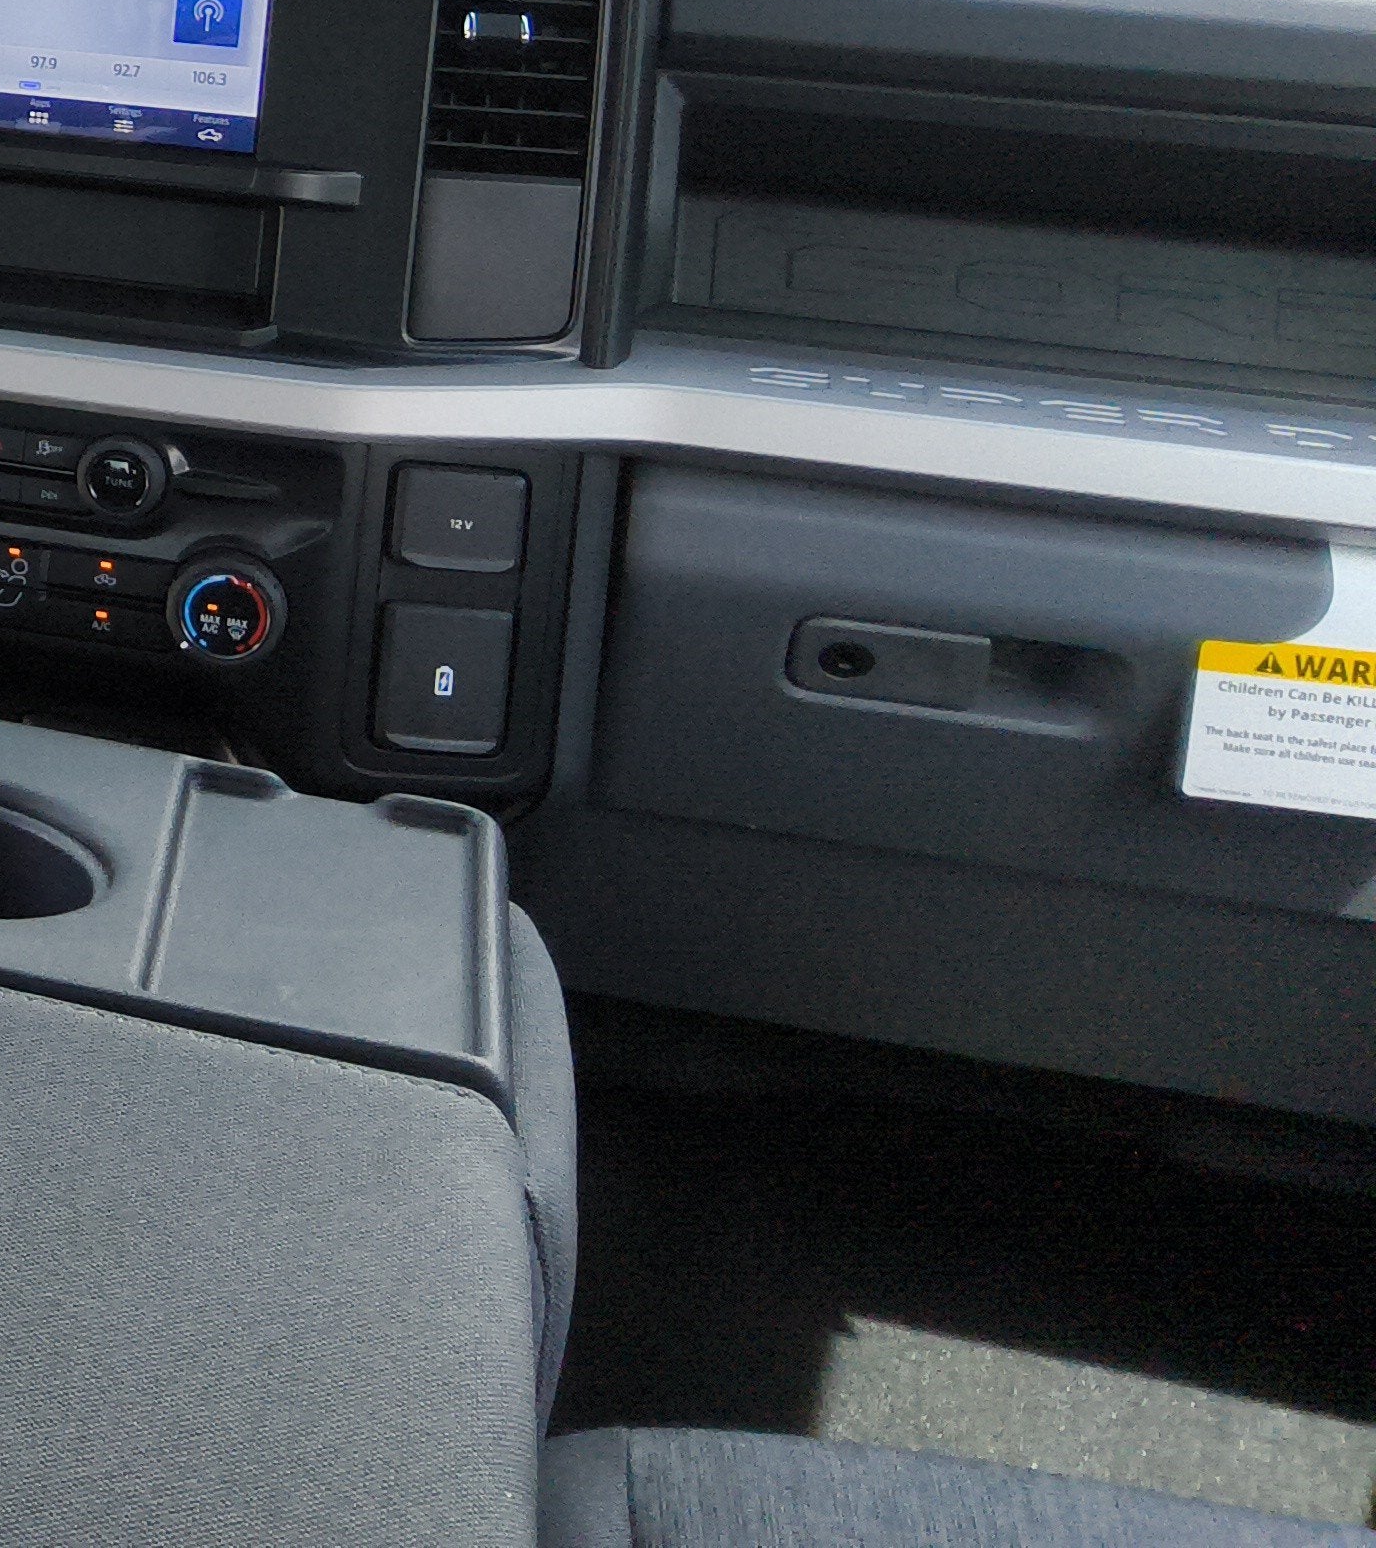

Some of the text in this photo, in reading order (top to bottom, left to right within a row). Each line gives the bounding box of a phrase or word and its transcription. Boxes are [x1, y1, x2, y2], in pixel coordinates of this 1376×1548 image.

[30, 55, 58, 70] 97.9
[113, 63, 141, 78] 92.7
[191, 70, 228, 86] 106.3
[104, 475, 134, 489] TUNE
[450, 518, 474, 530] 12 V
[91, 619, 111, 632] A/C
[200, 613, 221, 626] MAX
[226, 616, 248, 629] MAX
[201, 624, 219, 635] A/C
[1295, 653, 1376, 687] WAR
[1217, 680, 1284, 699] Children
[1287, 687, 1318, 702] Can
[1322, 691, 1342, 704] Be
[1268, 705, 1372, 729] by Passenger
[1205, 724, 1224, 737] The
[1226, 727, 1249, 739] back
[1252, 731, 1273, 742] seat
[1287, 735, 1305, 746] the
[1222, 741, 1251, 754] Make
